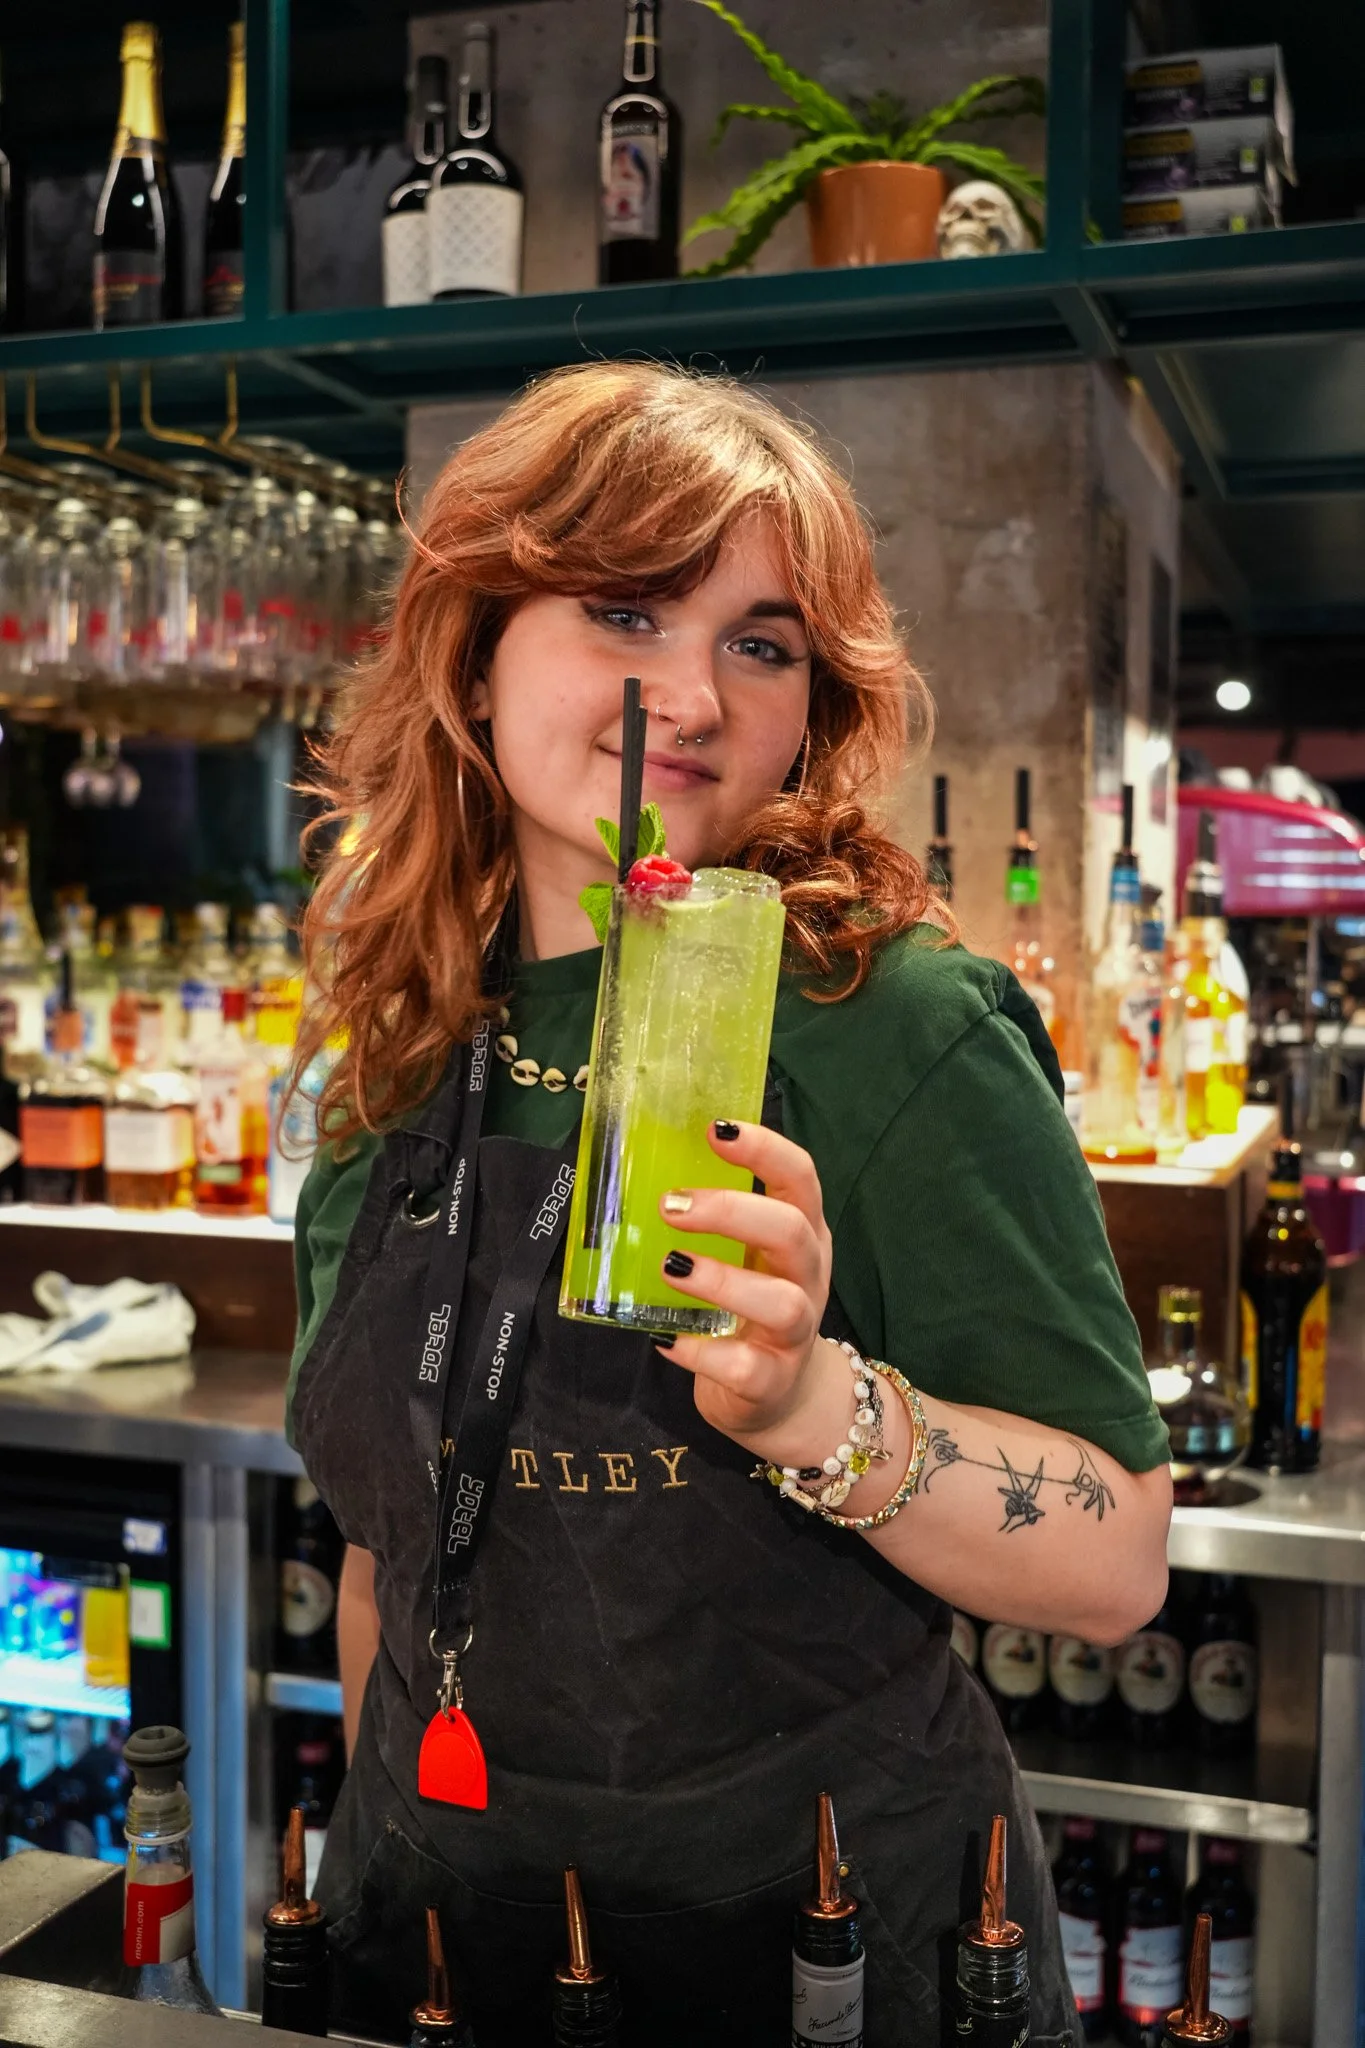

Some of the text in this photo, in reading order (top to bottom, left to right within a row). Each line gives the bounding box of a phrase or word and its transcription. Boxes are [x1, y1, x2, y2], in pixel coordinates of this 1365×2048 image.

[447, 1157, 467, 1236] NON-STOP
[485, 1311, 516, 1401] NON-STOP
[135, 1900, 145, 1960] monin.com
